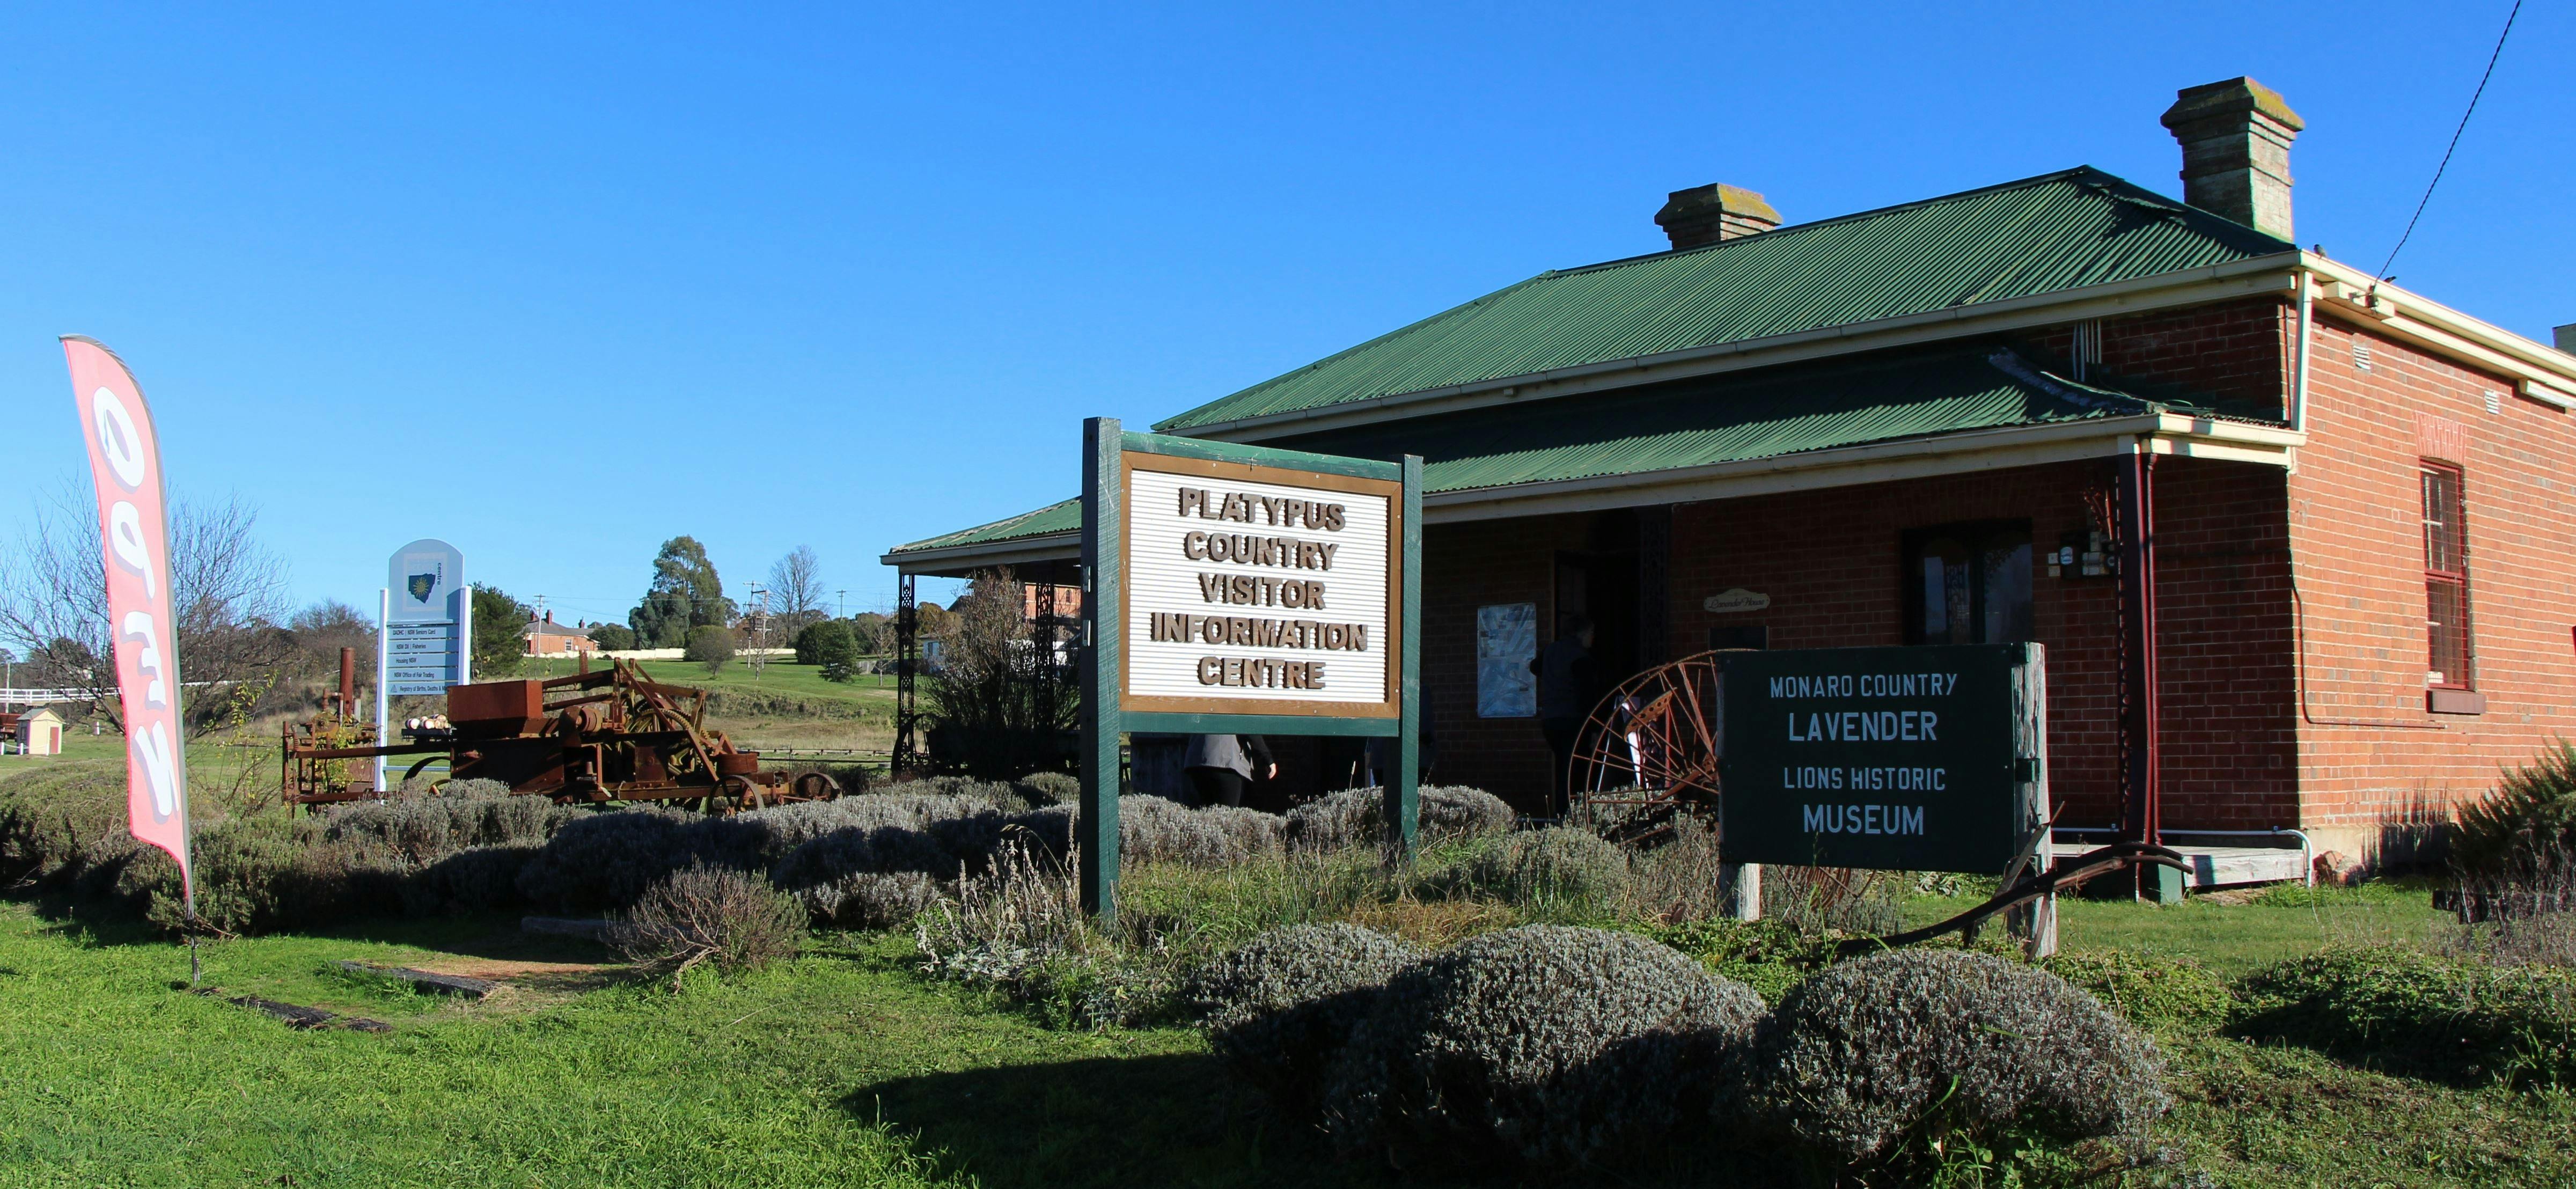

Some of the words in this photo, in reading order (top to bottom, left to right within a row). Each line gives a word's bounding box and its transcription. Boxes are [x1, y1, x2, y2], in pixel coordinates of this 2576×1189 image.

[1179, 487, 1346, 531] PLATYPUS
[1184, 531, 1339, 570] COUNTRY
[1199, 573, 1326, 610] VISITOR
[1151, 612, 1368, 651] INFORMATION
[1198, 657, 1326, 689] CENTRE
[1771, 676, 1853, 698] MONARO
[1861, 673, 1957, 696] COUNTRY
[1789, 711, 1937, 742] LAVENDER
[1784, 767, 1843, 789] LIONS
[1851, 768, 1946, 790] HISTORIC
[1804, 805, 1924, 835] MUSEUM
